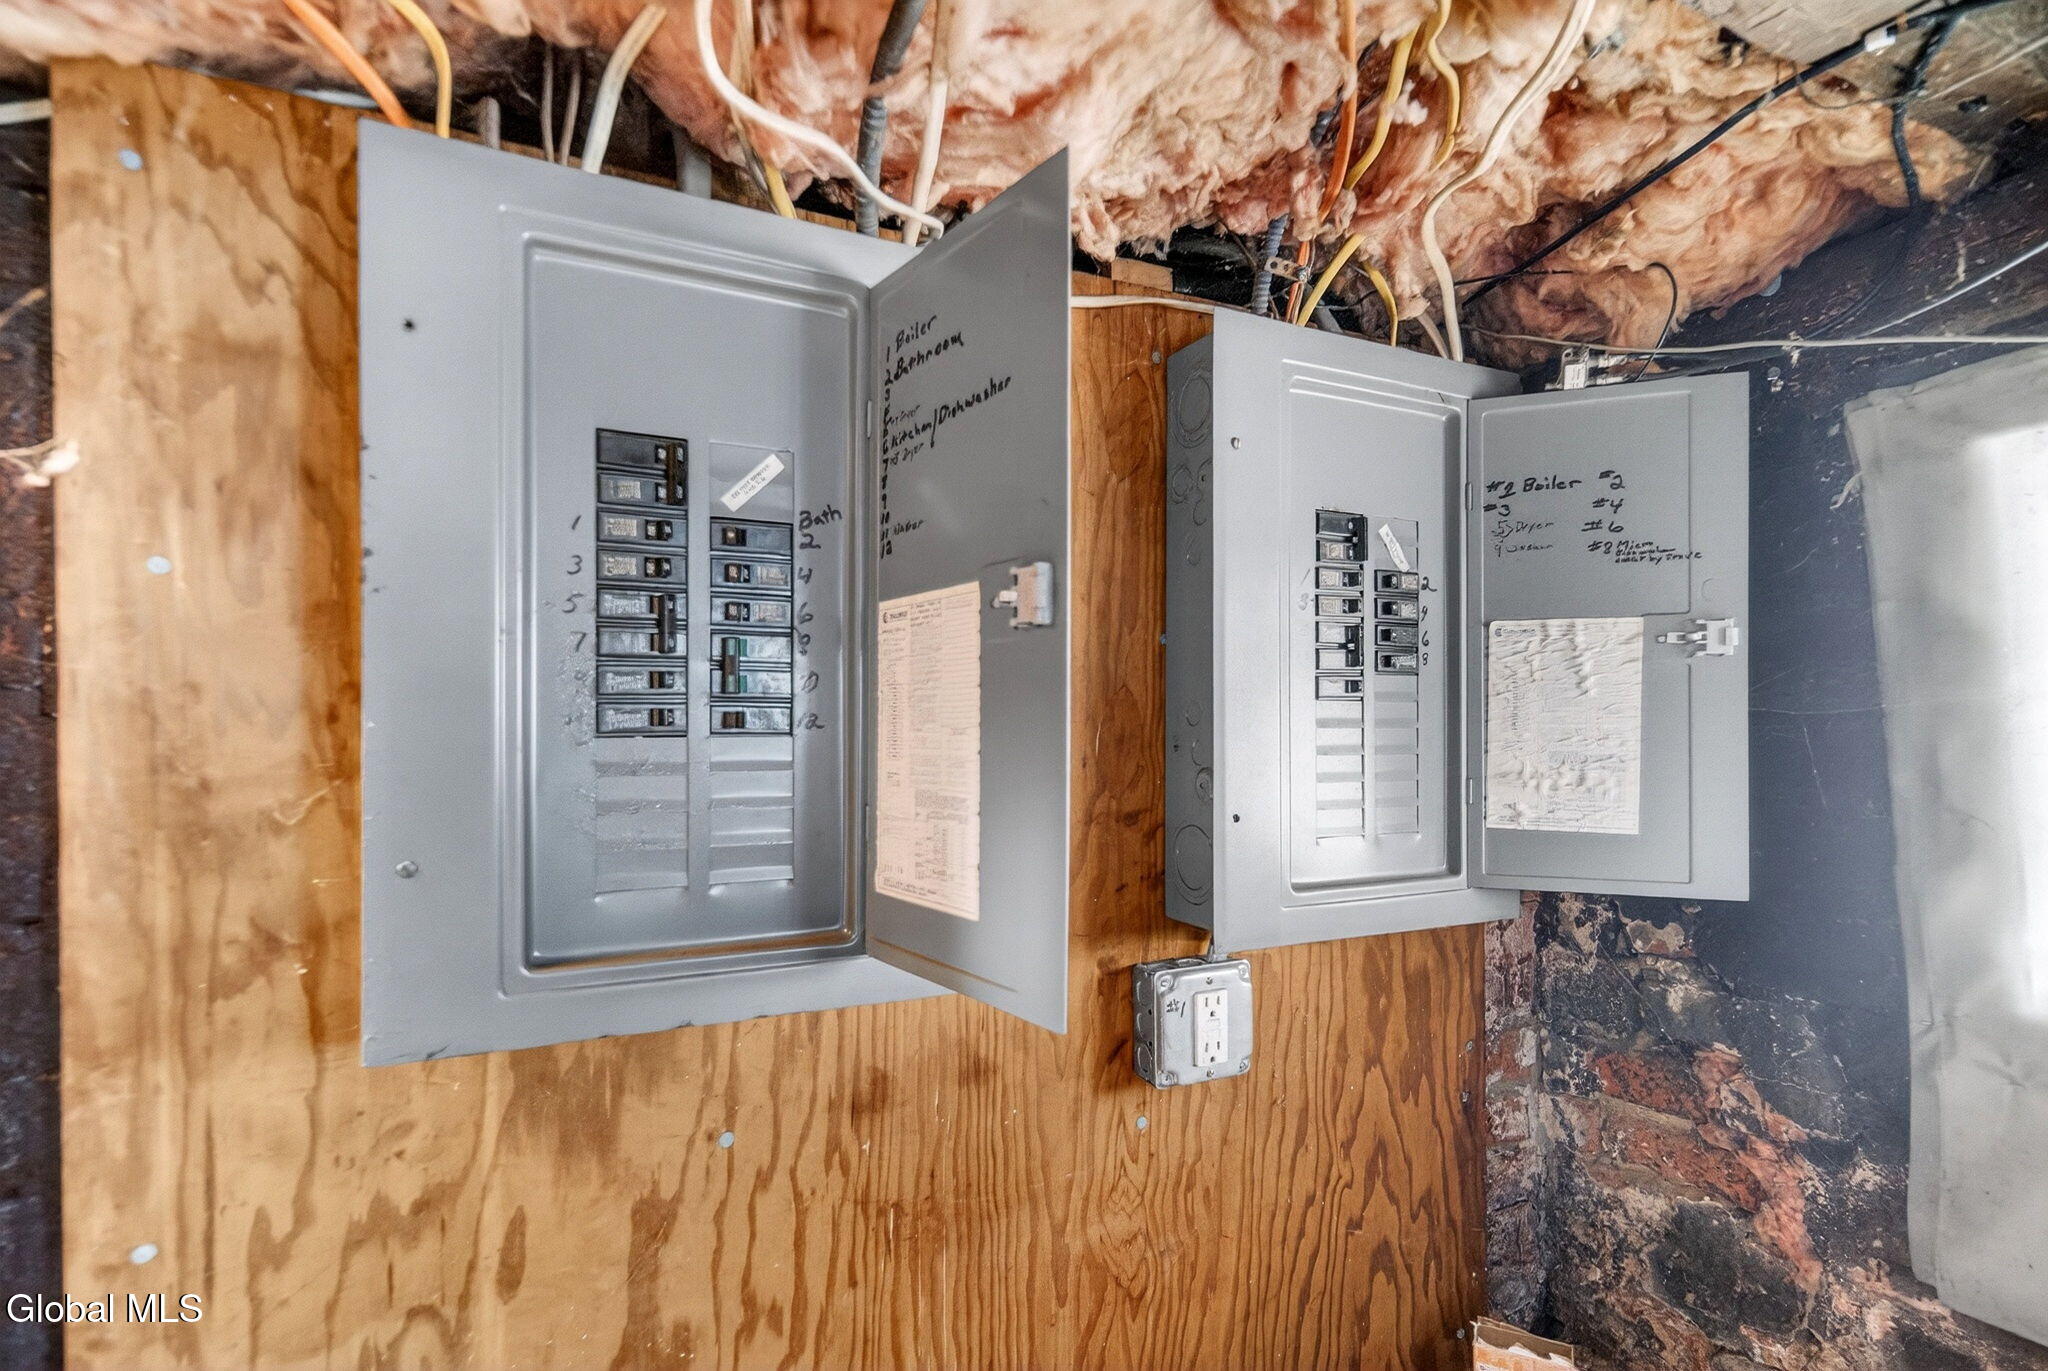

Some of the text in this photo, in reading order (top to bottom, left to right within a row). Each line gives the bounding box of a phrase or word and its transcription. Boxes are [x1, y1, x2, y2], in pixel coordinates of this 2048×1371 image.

[896, 315, 937, 353] Boiler
[1522, 474, 1582, 493] Boiler
[1592, 497, 1624, 514] #4
[799, 504, 843, 531] Bath
[1581, 519, 1624, 533] #6
[800, 532, 822, 550] 2
[566, 554, 583, 576] 3
[1420, 576, 1438, 592] 2
[562, 592, 584, 614] 5
[798, 601, 814, 625] 6
[570, 630, 588, 652] 7
[1421, 630, 1430, 647] 6
